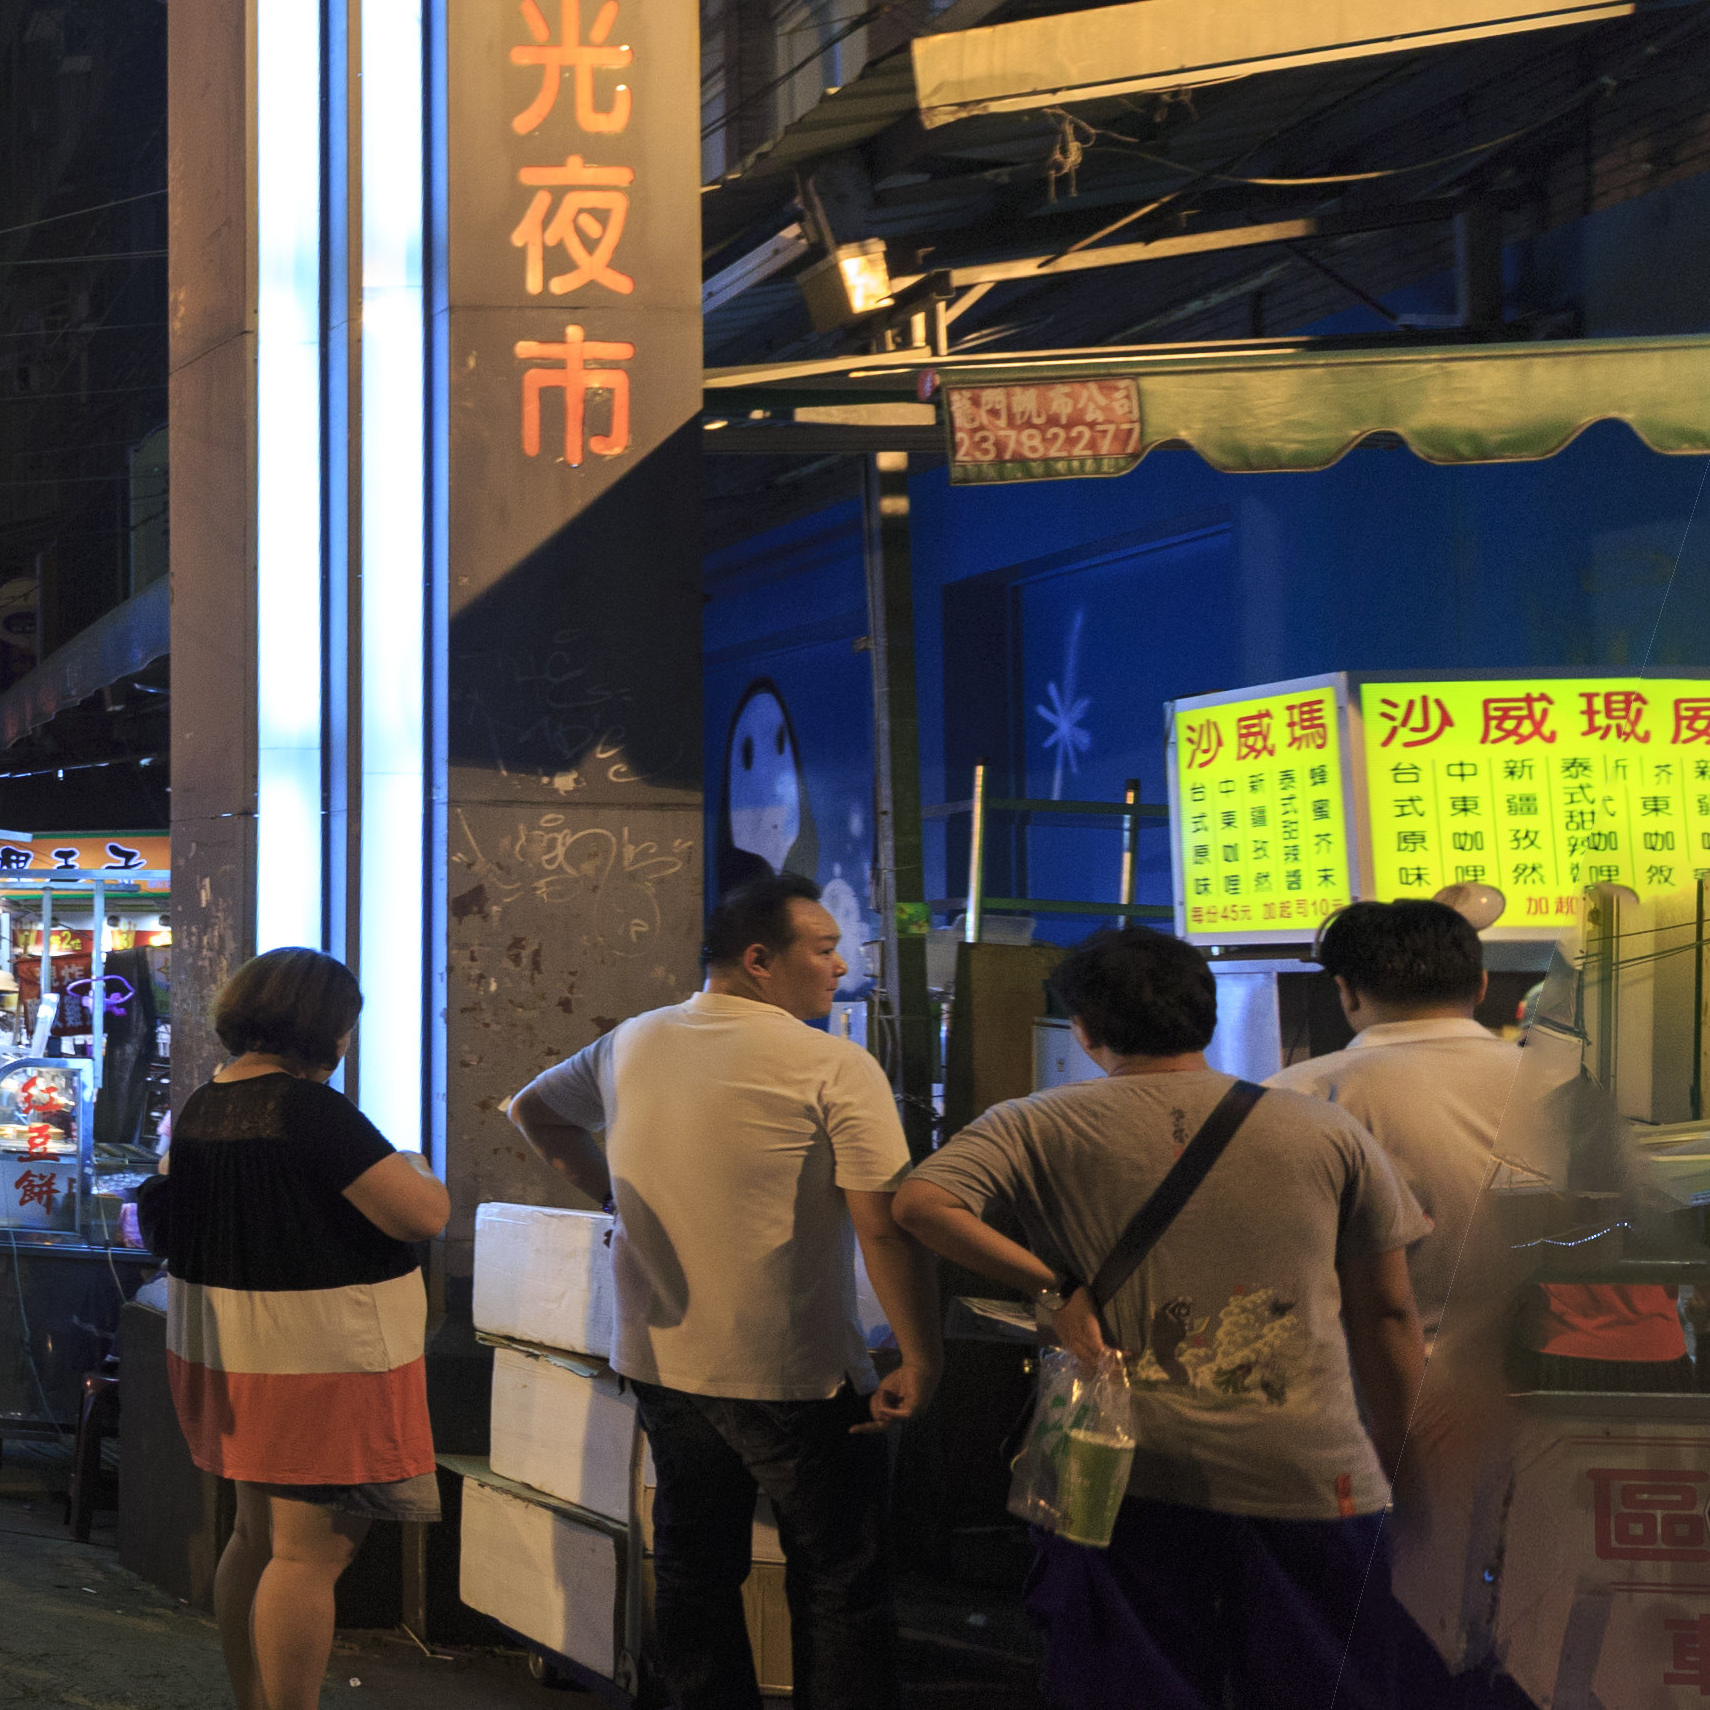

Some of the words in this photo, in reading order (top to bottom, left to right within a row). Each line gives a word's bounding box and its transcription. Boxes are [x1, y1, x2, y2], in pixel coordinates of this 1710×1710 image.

[955, 422, 1141, 461] 23782277
[1186, 699, 1327, 769] 沙威瑪
[1190, 783, 1212, 895] 台式原味
[1219, 779, 1241, 895] 中東咖哩
[1310, 764, 1336, 888] 蜂蜜芥末
[1389, 762, 1432, 887] 台式原味
[1447, 760, 1486, 883] 中東咖哩
[1503, 758, 1546, 886] 新疆孜然
[14, 1076, 64, 1215] 紅豆餅
